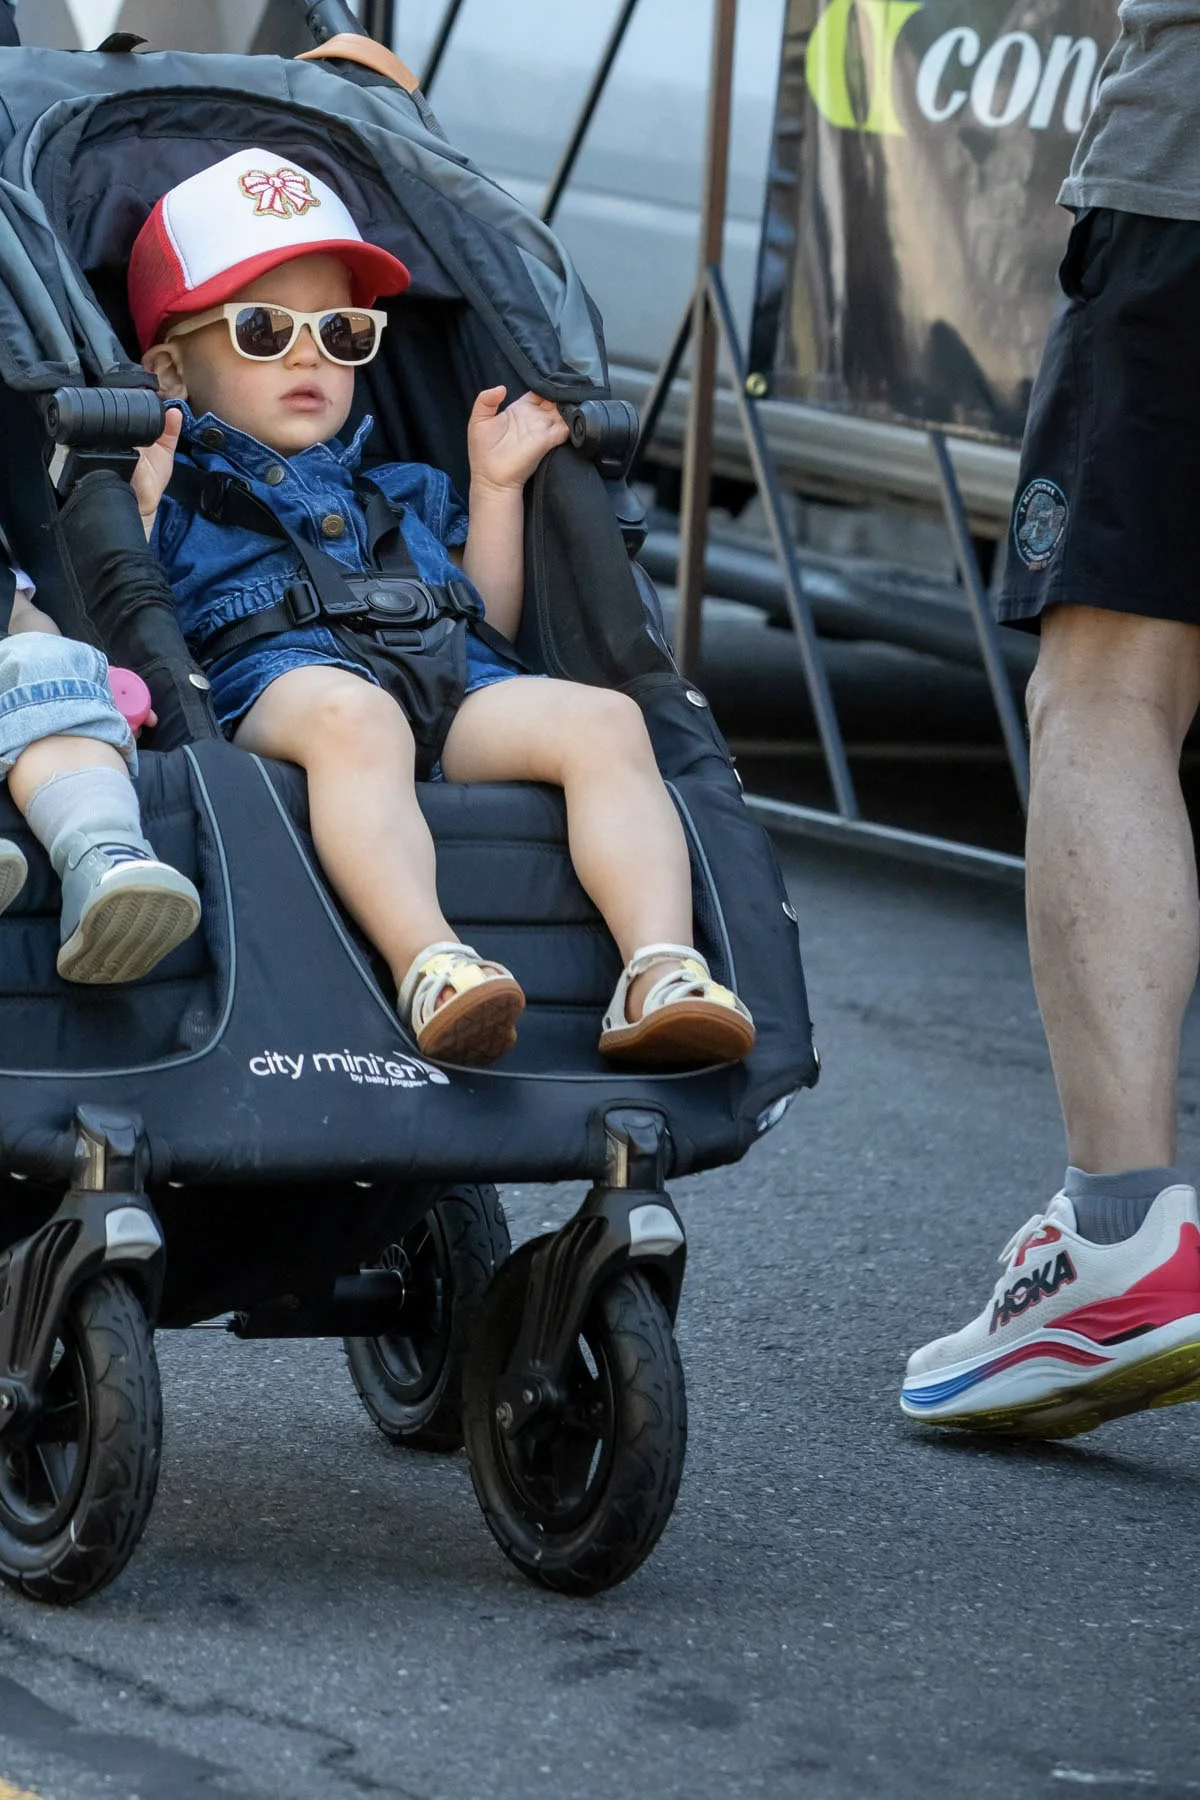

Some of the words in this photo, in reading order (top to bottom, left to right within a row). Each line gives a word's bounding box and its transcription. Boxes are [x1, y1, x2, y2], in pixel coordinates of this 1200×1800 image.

[916, 25, 1101, 134] con
[249, 1050, 304, 1080] city
[312, 1048, 381, 1076] mini
[384, 1059, 417, 1080] GT
[350, 1072, 363, 1085] by
[988, 1250, 1078, 1336] HOKA
